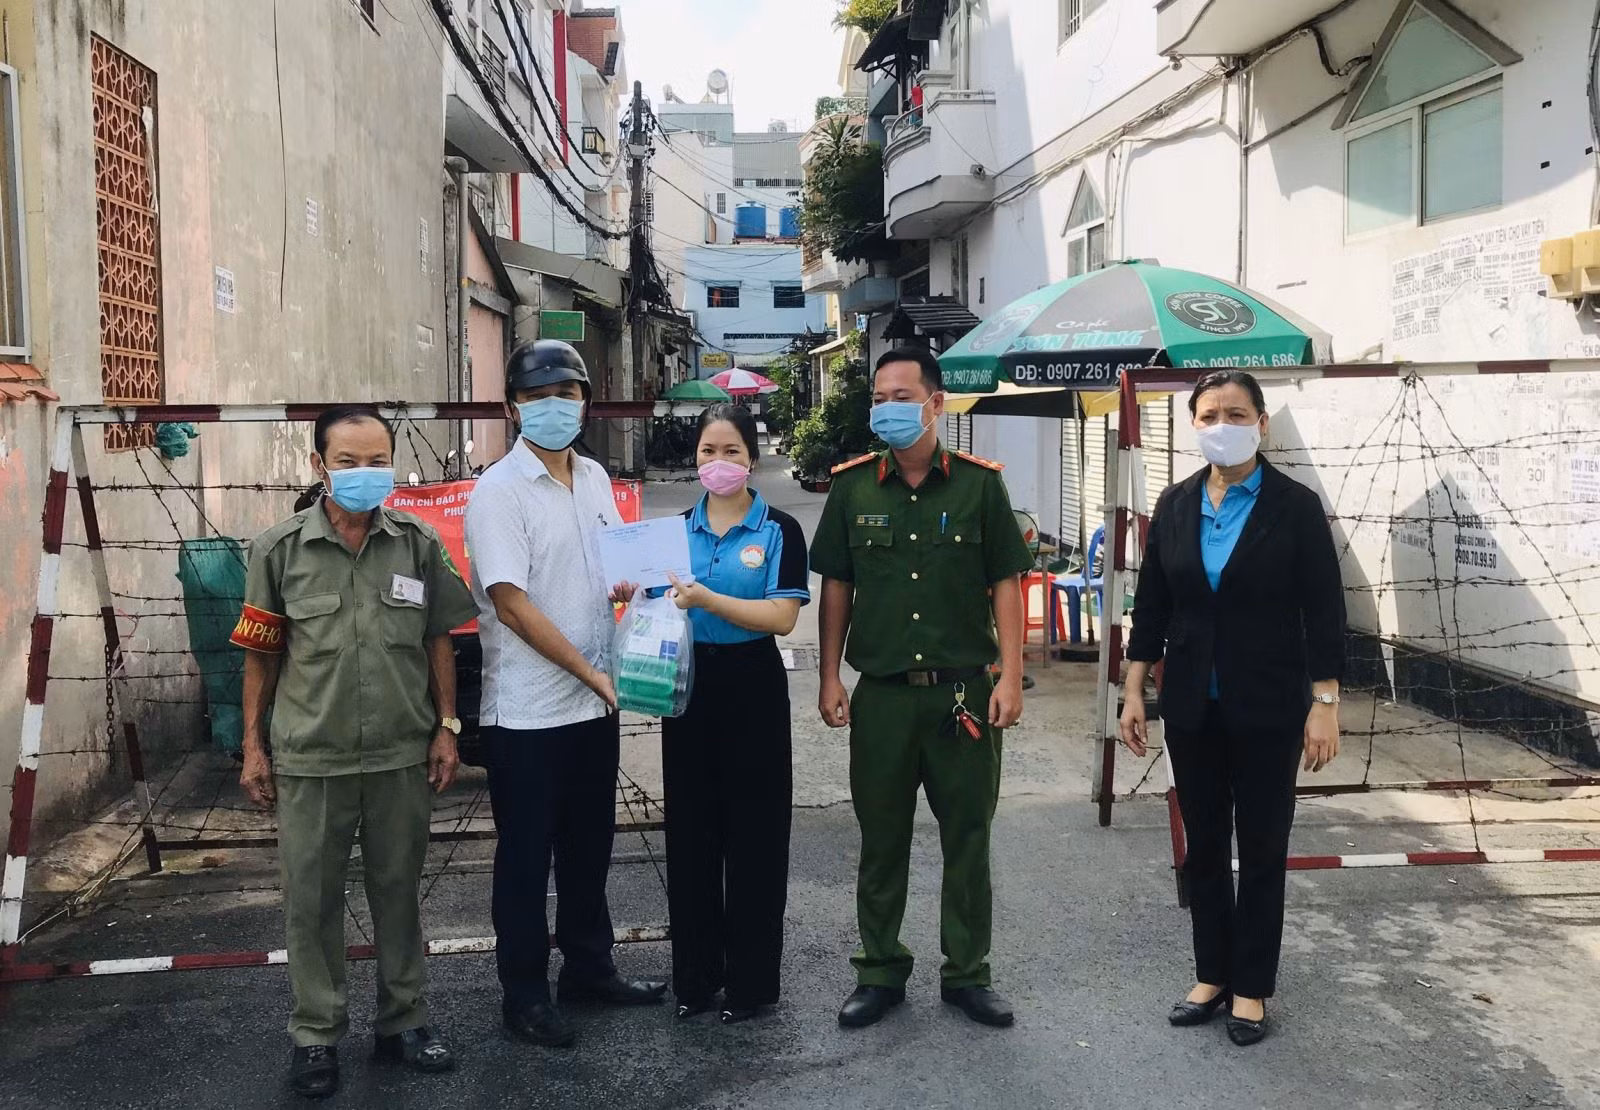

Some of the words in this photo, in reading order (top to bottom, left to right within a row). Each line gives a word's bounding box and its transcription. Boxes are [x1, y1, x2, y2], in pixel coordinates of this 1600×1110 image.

[1204, 293, 1244, 309] COFFEE
[1200, 324, 1231, 333] SINCE
[1015, 364, 1042, 381] DĐ:
[1046, 362, 1111, 380] 0907.261
[393, 497, 414, 507] BAN
